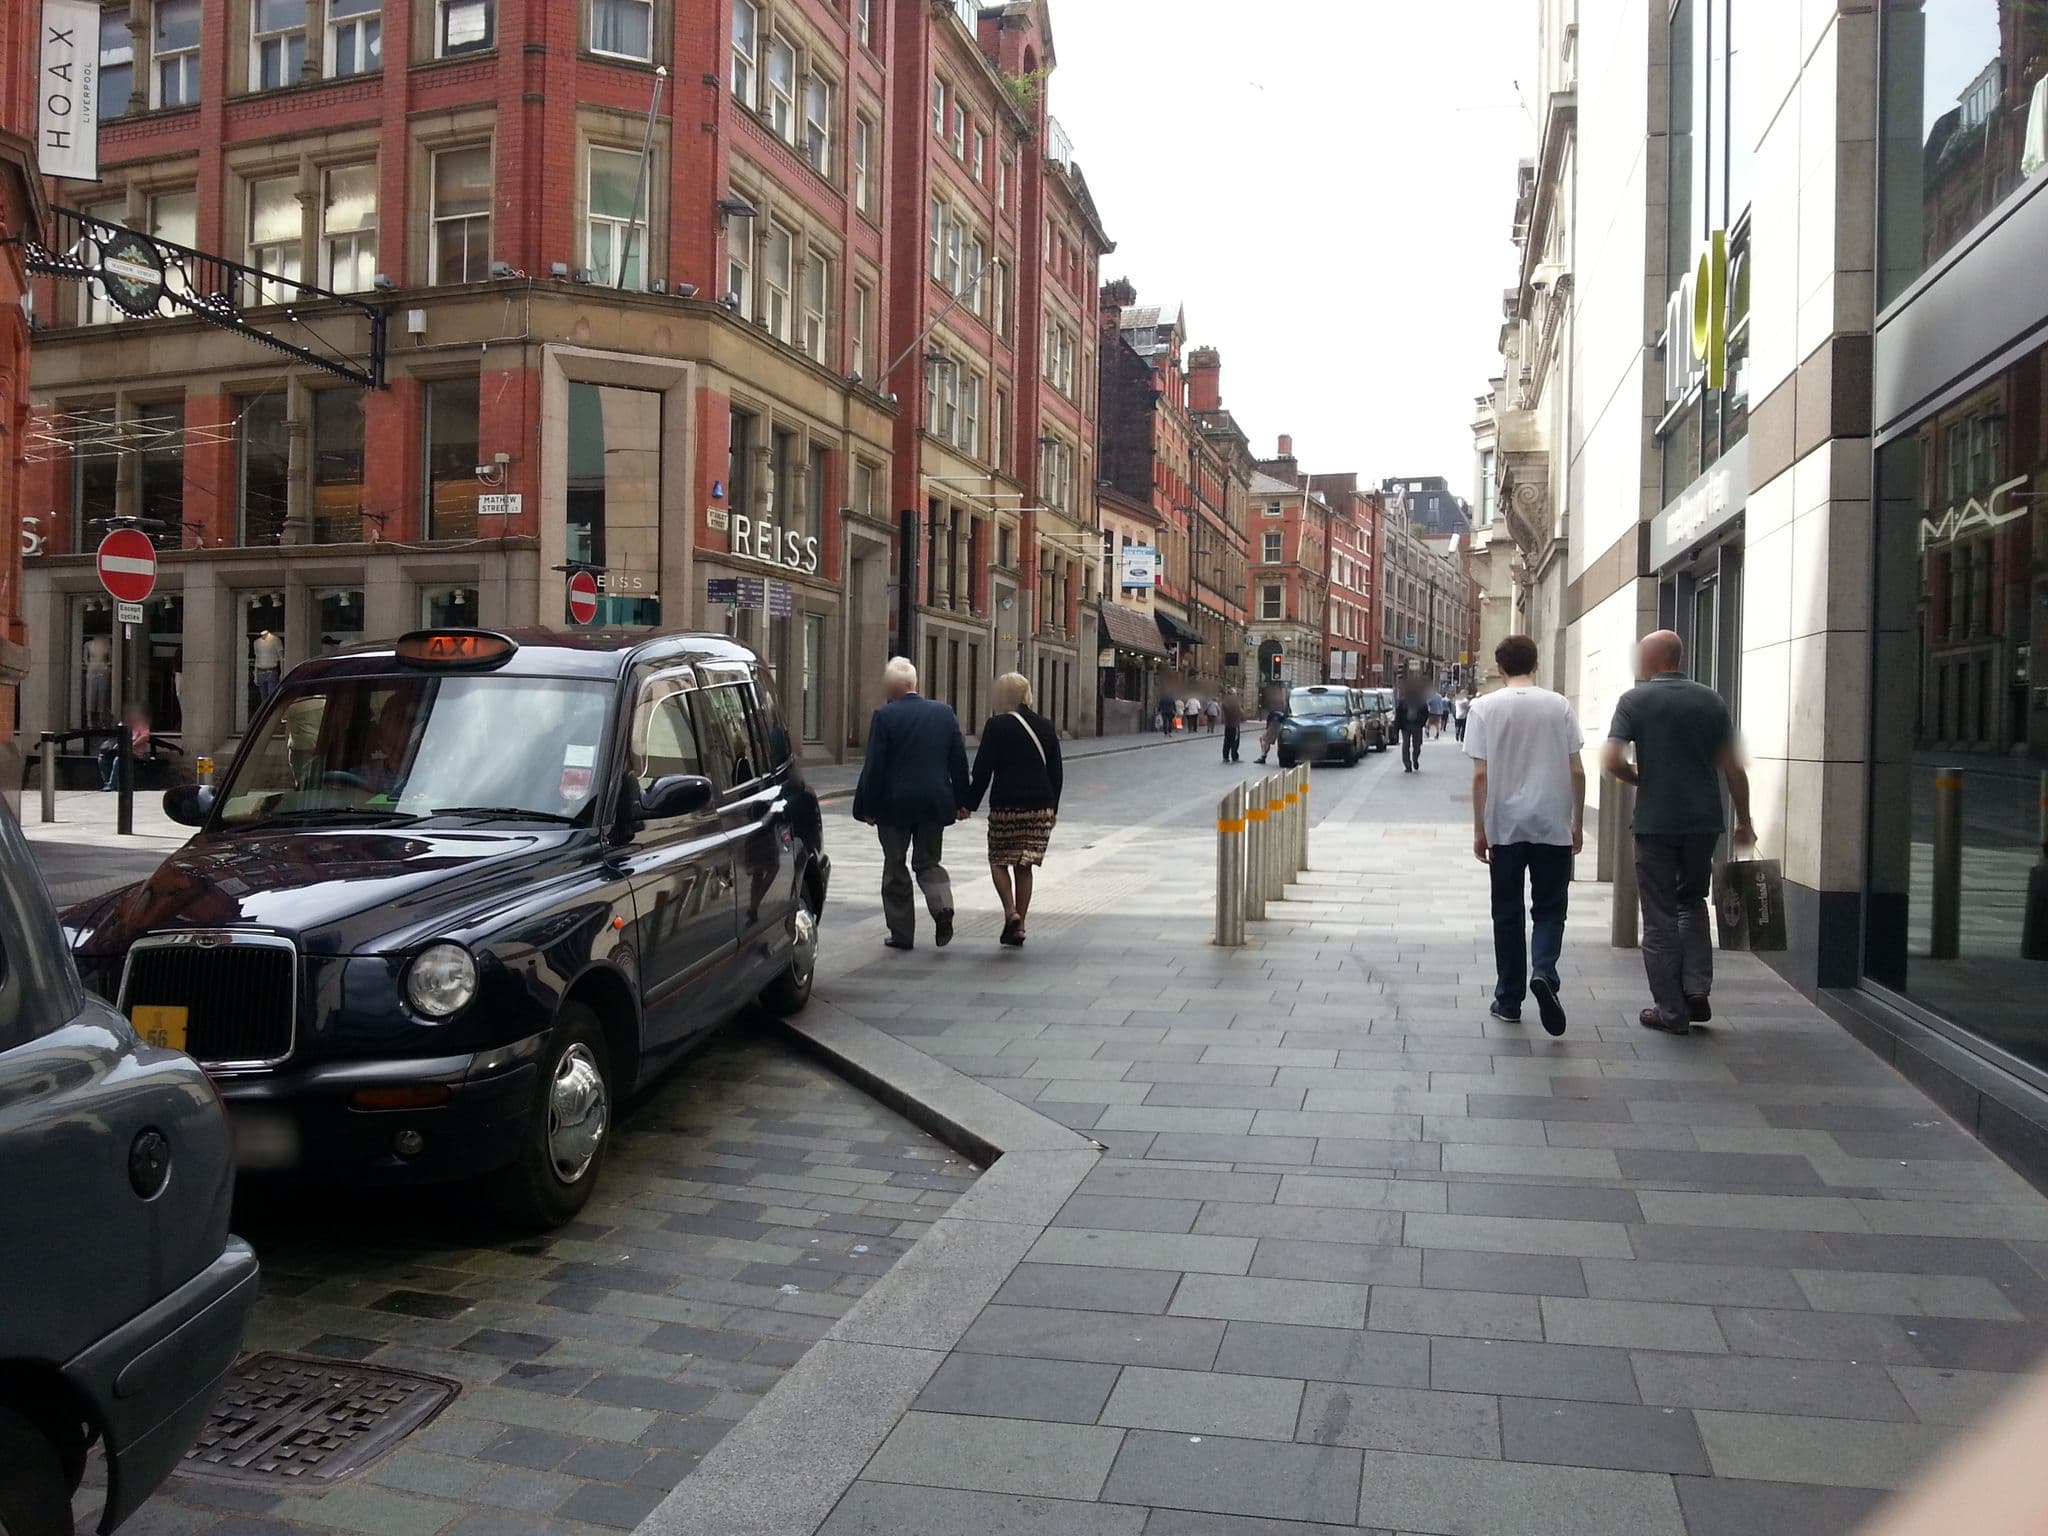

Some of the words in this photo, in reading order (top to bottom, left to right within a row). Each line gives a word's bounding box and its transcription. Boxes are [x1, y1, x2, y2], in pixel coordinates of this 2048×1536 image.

[47, 26, 74, 149] HOAX
[83, 62, 92, 124] LIVERPOOL
[482, 504, 508, 512] STREET
[732, 514, 818, 571] REISS
[597, 575, 642, 589] EISS
[1756, 883, 1769, 925] Timberland
